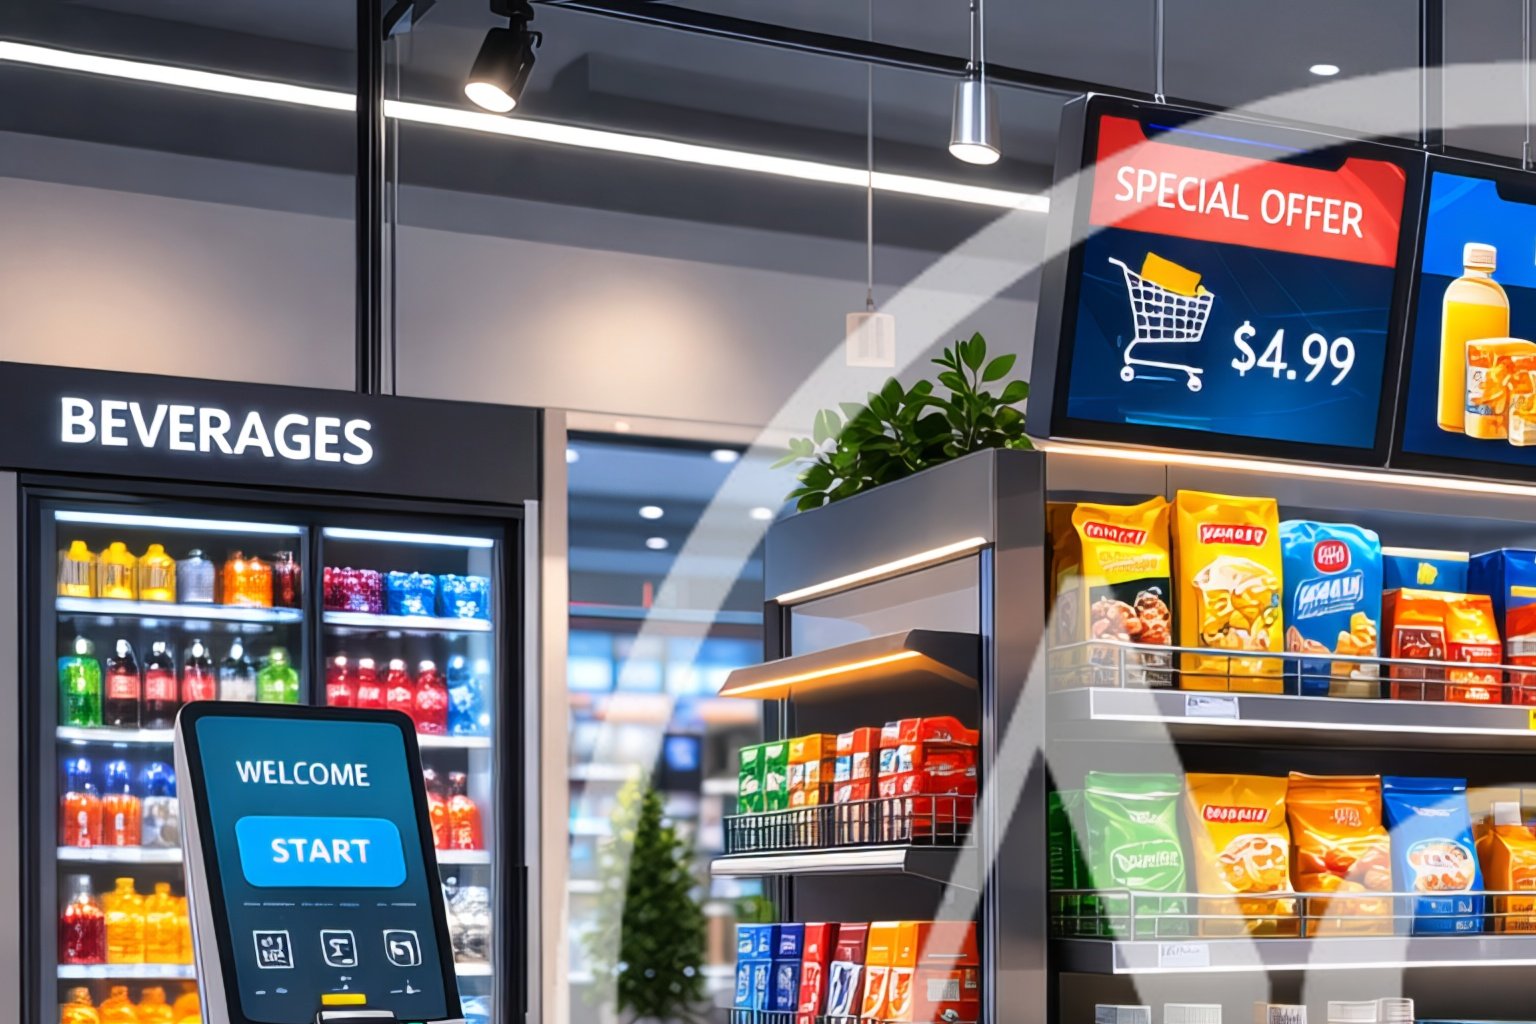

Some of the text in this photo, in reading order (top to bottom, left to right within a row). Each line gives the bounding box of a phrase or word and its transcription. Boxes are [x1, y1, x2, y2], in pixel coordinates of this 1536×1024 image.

[1114, 165, 1363, 238] SPECIAL OFFER
[1231, 320, 1355, 386] $4.99
[61, 397, 374, 465] BEVERAGES
[235, 760, 370, 787] WELCOME
[271, 838, 371, 863] START
